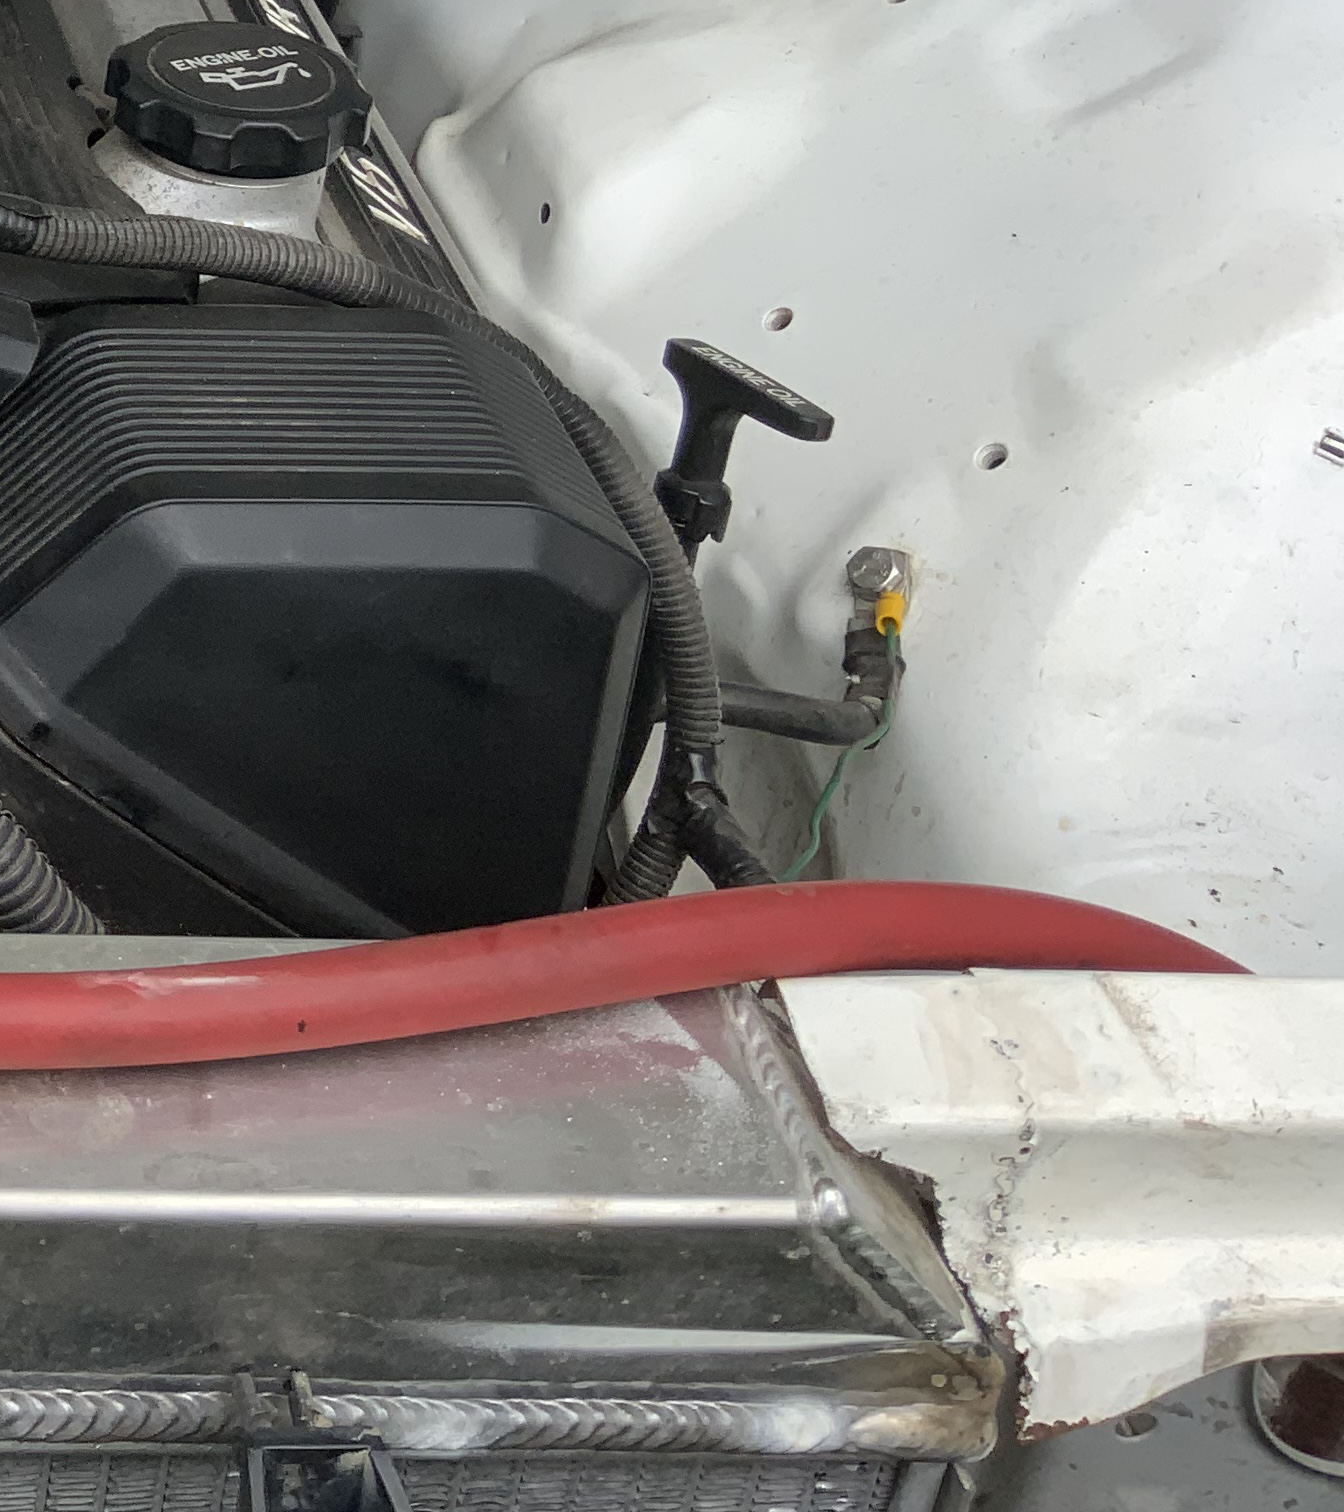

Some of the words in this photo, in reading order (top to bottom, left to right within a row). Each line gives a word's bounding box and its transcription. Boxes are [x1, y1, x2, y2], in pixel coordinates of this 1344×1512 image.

[169, 49, 255, 74] ENGINE
[257, 43, 300, 60] OIL
[691, 345, 778, 388] ENGINE
[766, 387, 808, 408] OIL
